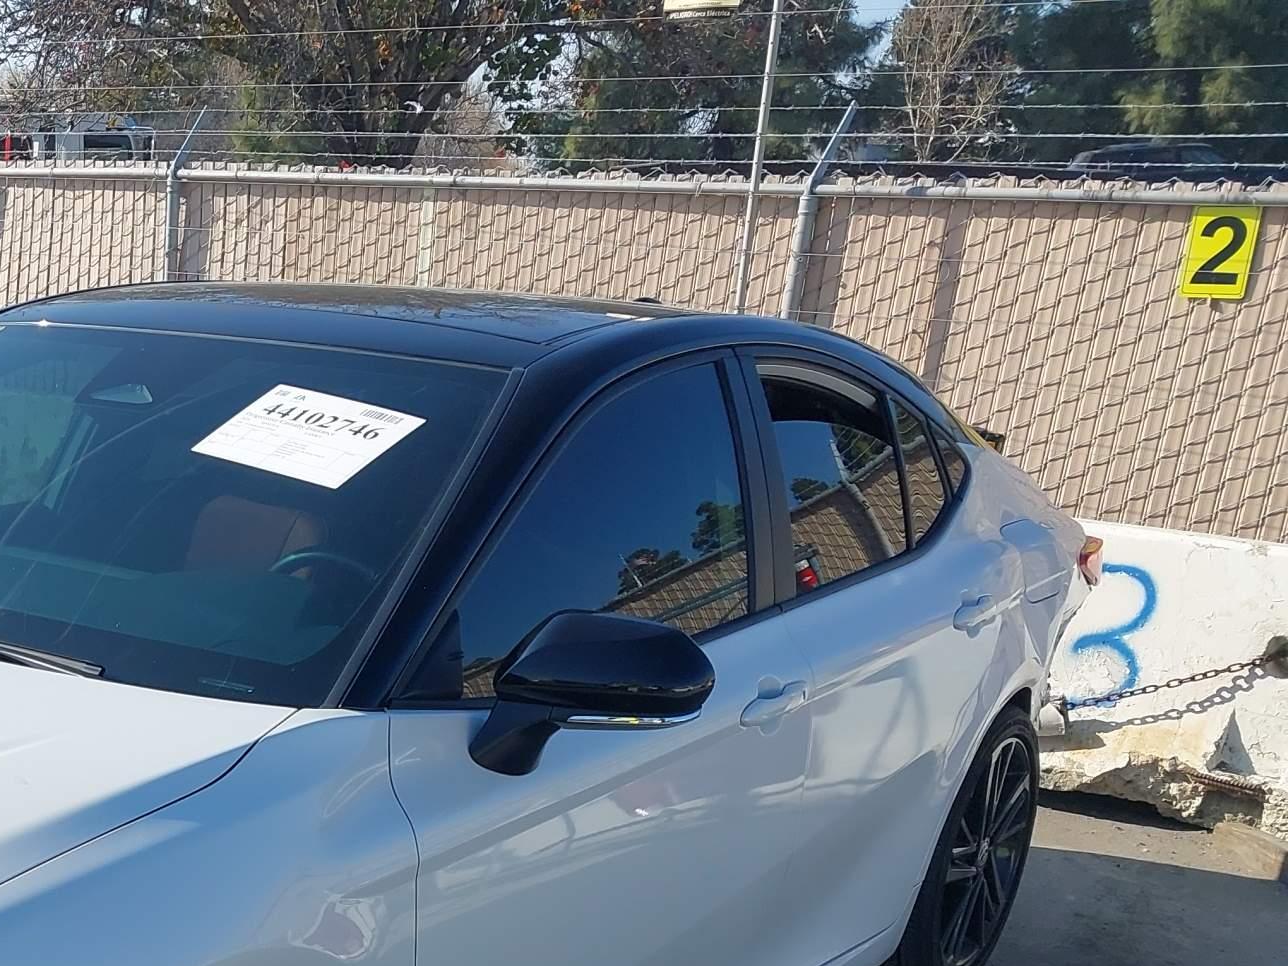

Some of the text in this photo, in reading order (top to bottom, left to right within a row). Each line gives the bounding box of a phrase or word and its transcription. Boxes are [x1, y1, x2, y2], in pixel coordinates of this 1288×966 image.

[1189, 215, 1248, 286] 2
[263, 403, 385, 440] 44102746
[1067, 562, 1157, 710] 3
